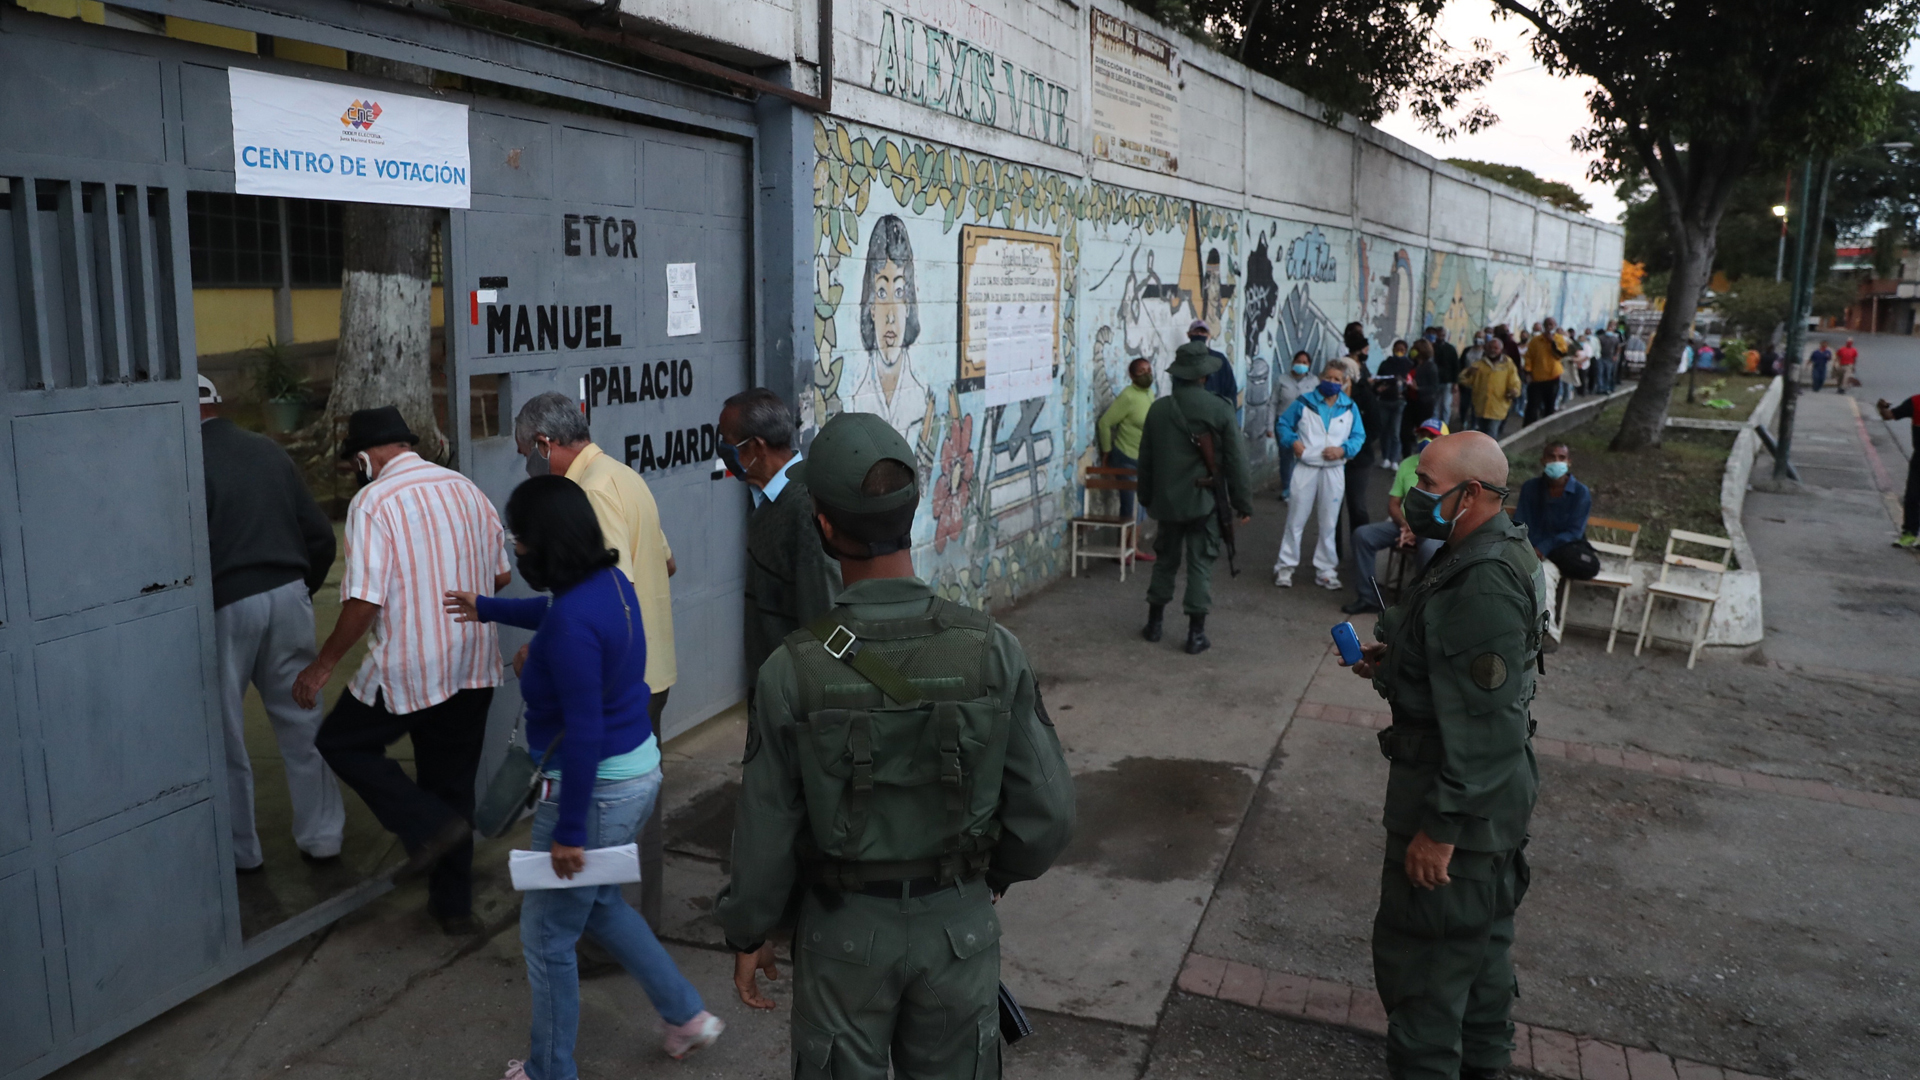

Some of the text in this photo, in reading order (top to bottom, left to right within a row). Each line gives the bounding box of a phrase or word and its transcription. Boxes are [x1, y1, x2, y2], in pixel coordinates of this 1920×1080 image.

[871, 10, 997, 127] ALEXIS
[1001, 59, 1070, 149] VIVE
[1124, 67, 1131, 76] DE
[347, 107, 375, 123] CNE
[242, 145, 466, 185] CENTRO DE VOTACIÓN
[563, 213, 639, 259] ETCR
[486, 304, 622, 354] MANUEL
[590, 359, 693, 407] PALACIO
